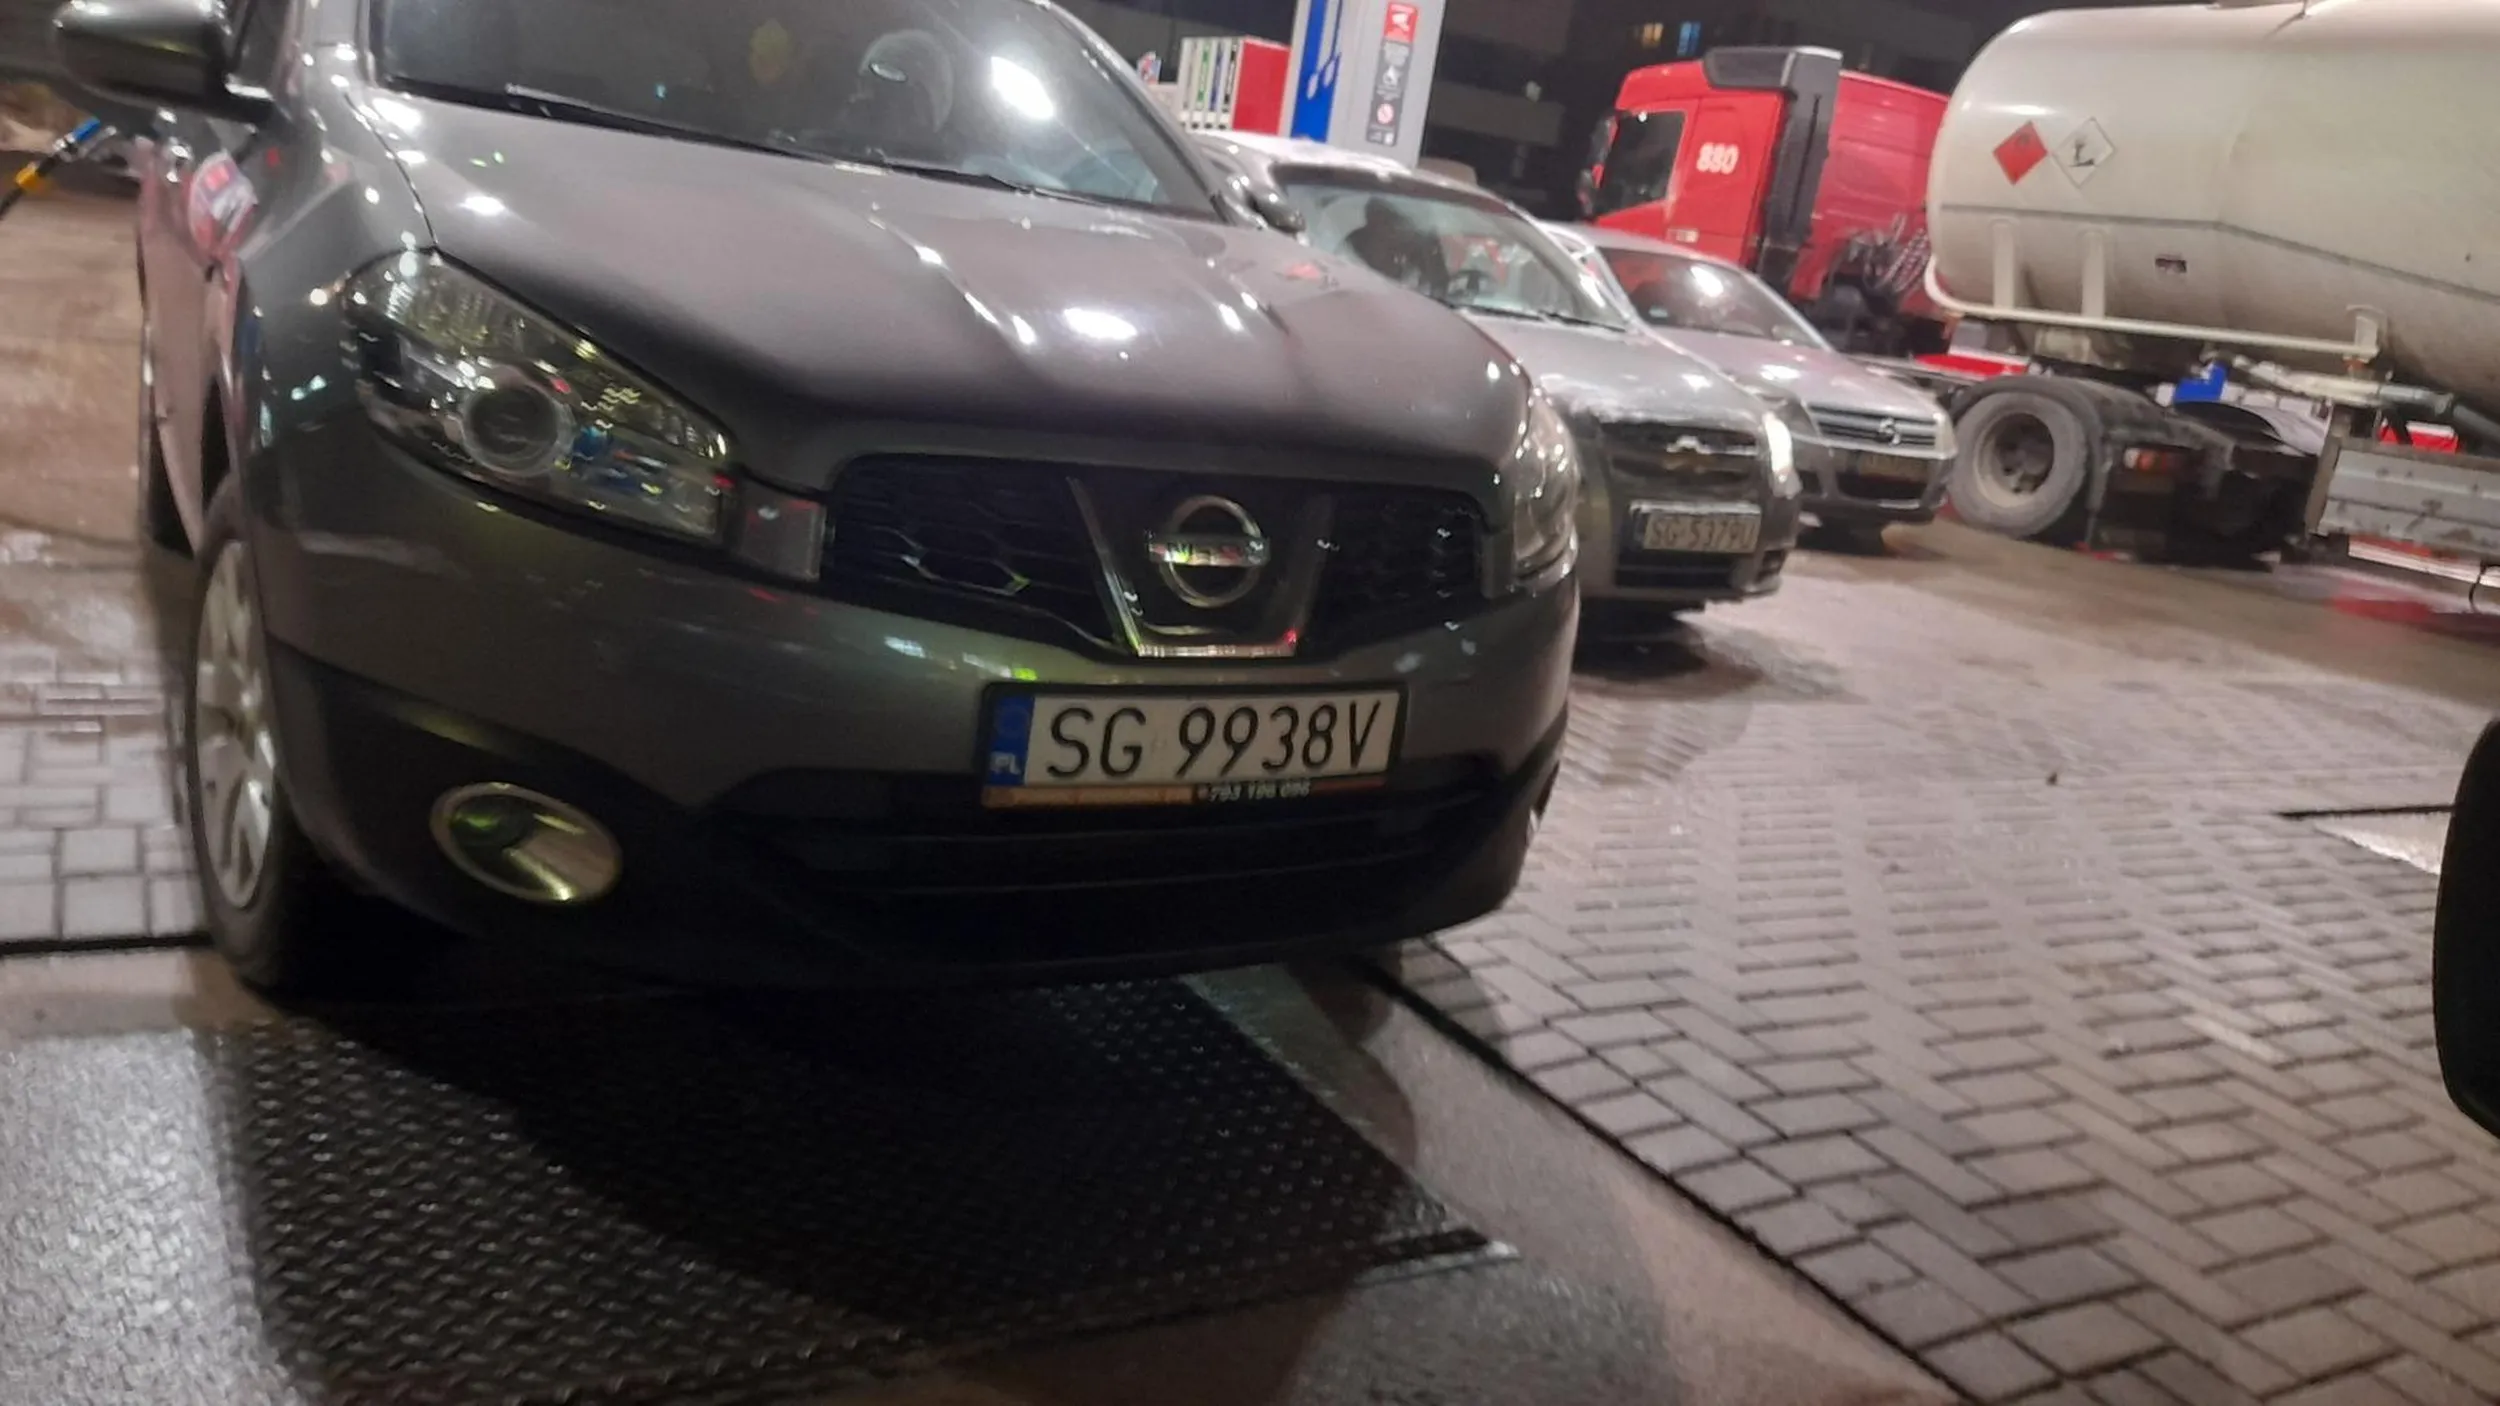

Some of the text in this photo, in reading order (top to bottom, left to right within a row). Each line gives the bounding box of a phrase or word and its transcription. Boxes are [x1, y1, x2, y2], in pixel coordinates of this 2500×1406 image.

[990, 751, 1021, 776] PL
[1046, 700, 1381, 778] SG 9938V
